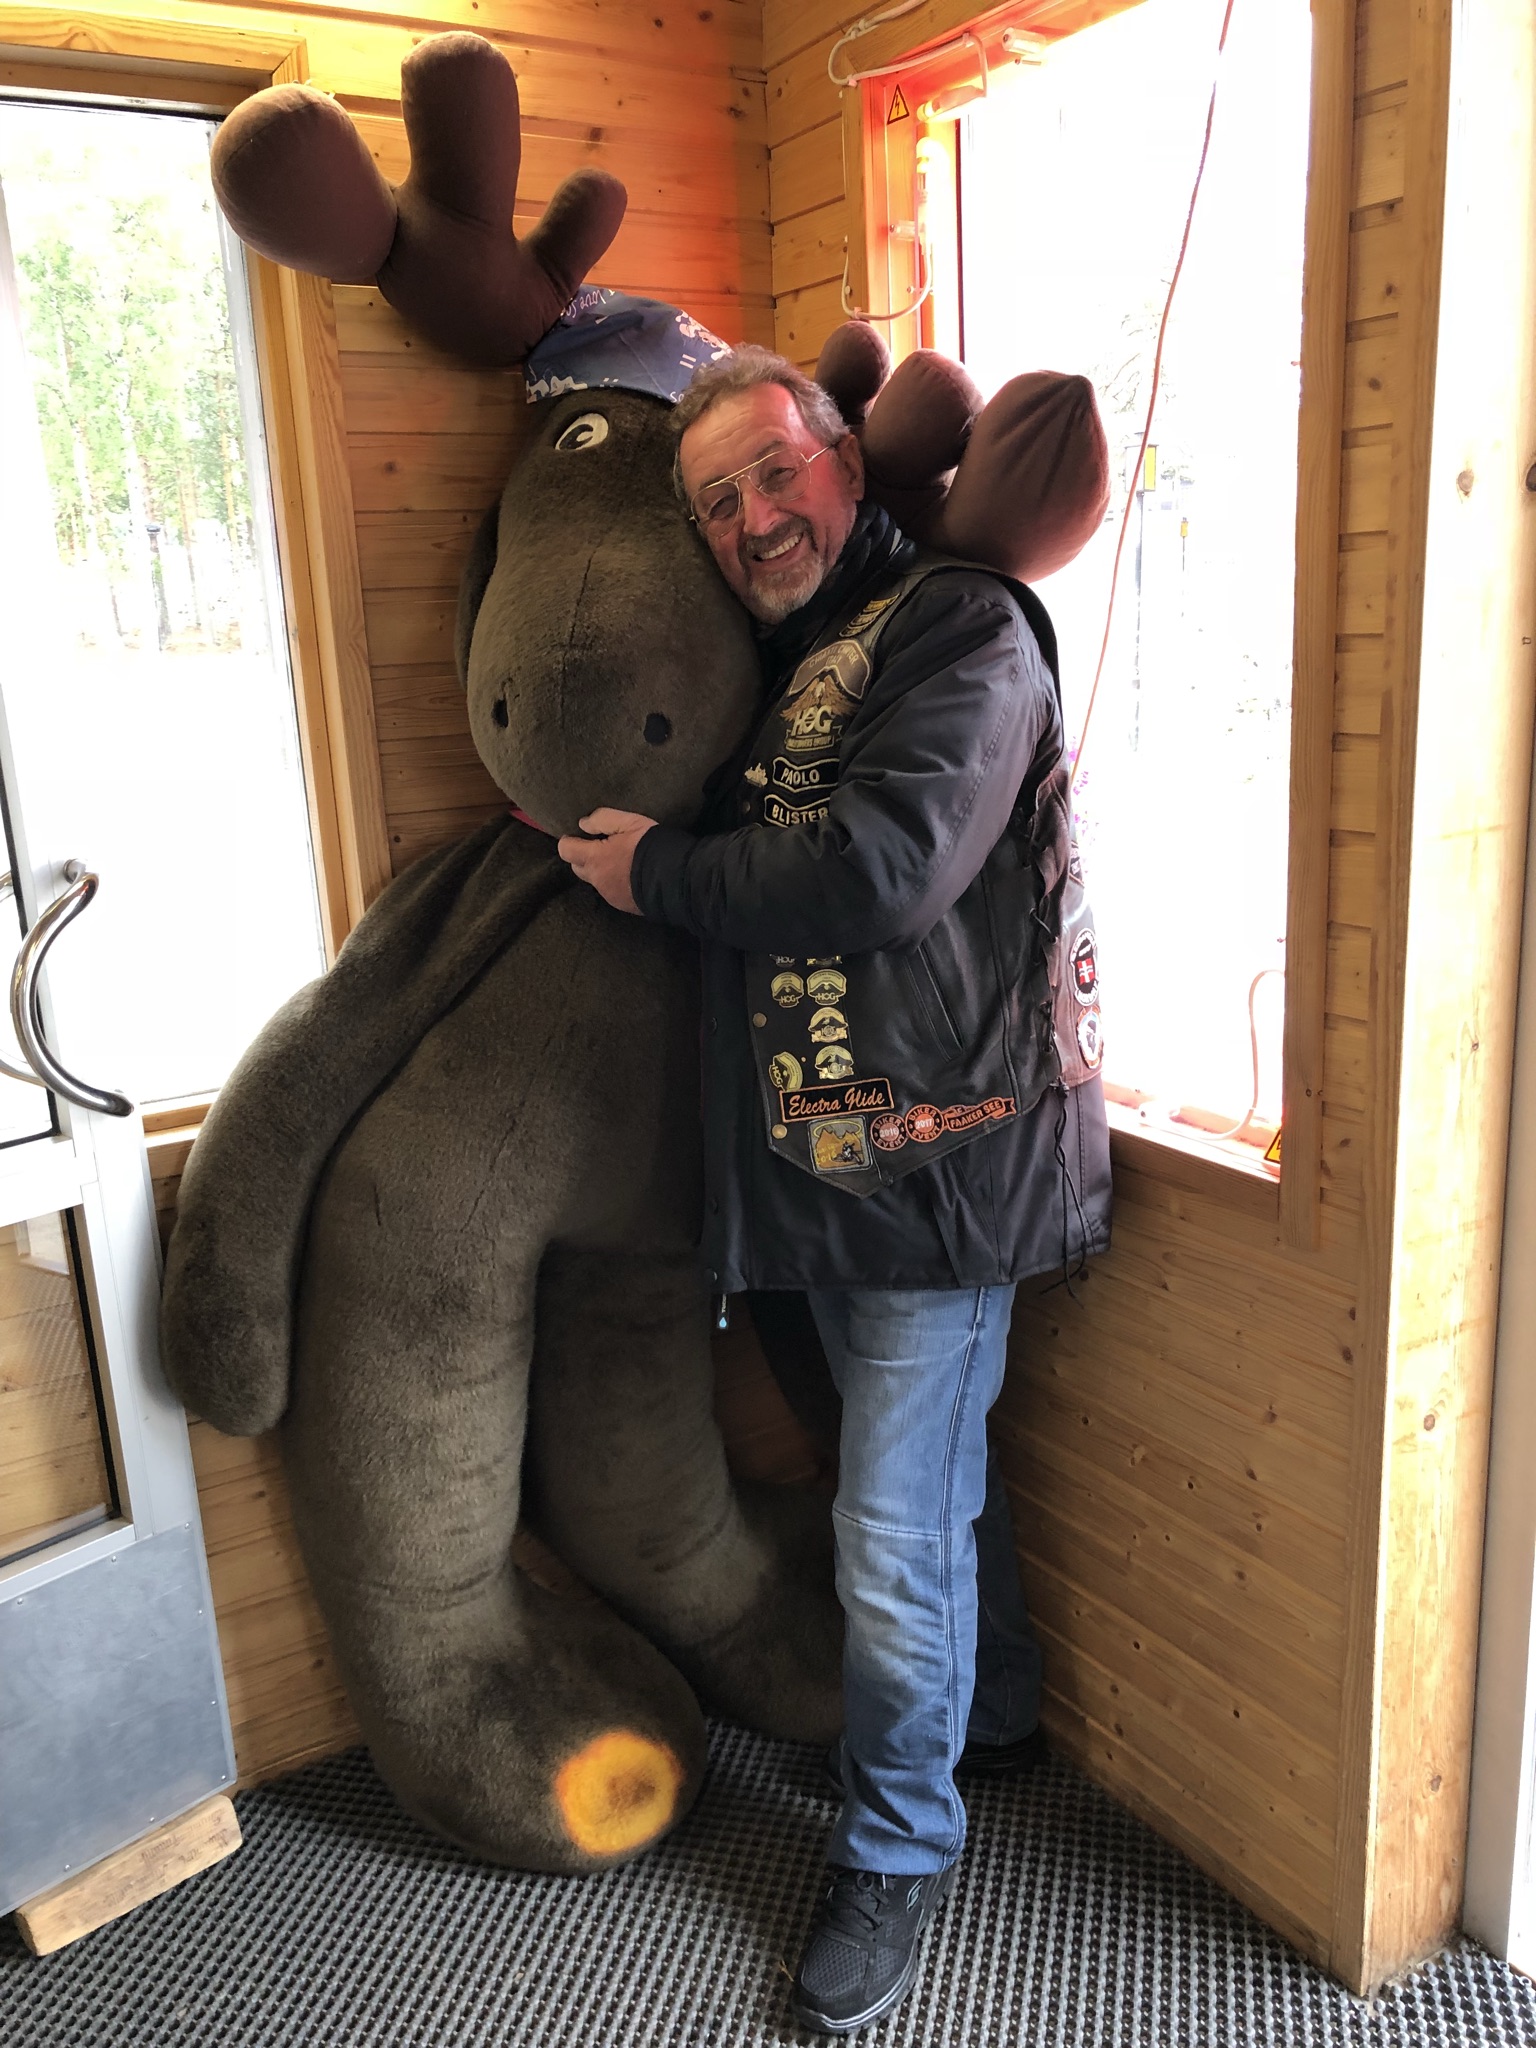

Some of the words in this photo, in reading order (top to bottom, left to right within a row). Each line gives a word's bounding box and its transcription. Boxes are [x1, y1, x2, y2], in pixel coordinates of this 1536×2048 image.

[780, 767, 820, 785] PAOLO
[771, 804, 829, 825] BLISTER
[788, 1094, 842, 1117] Electra
[844, 1086, 886, 1111] Glide
[909, 1107, 937, 1121] BIKER
[950, 1110, 984, 1128] FAAKER
[983, 1100, 1002, 1114] SEE
[874, 1116, 901, 1130] BIKER
[914, 1118, 934, 1129] 2017
[911, 1126, 941, 1140] EVENT
[877, 1134, 905, 1148] EVENT
